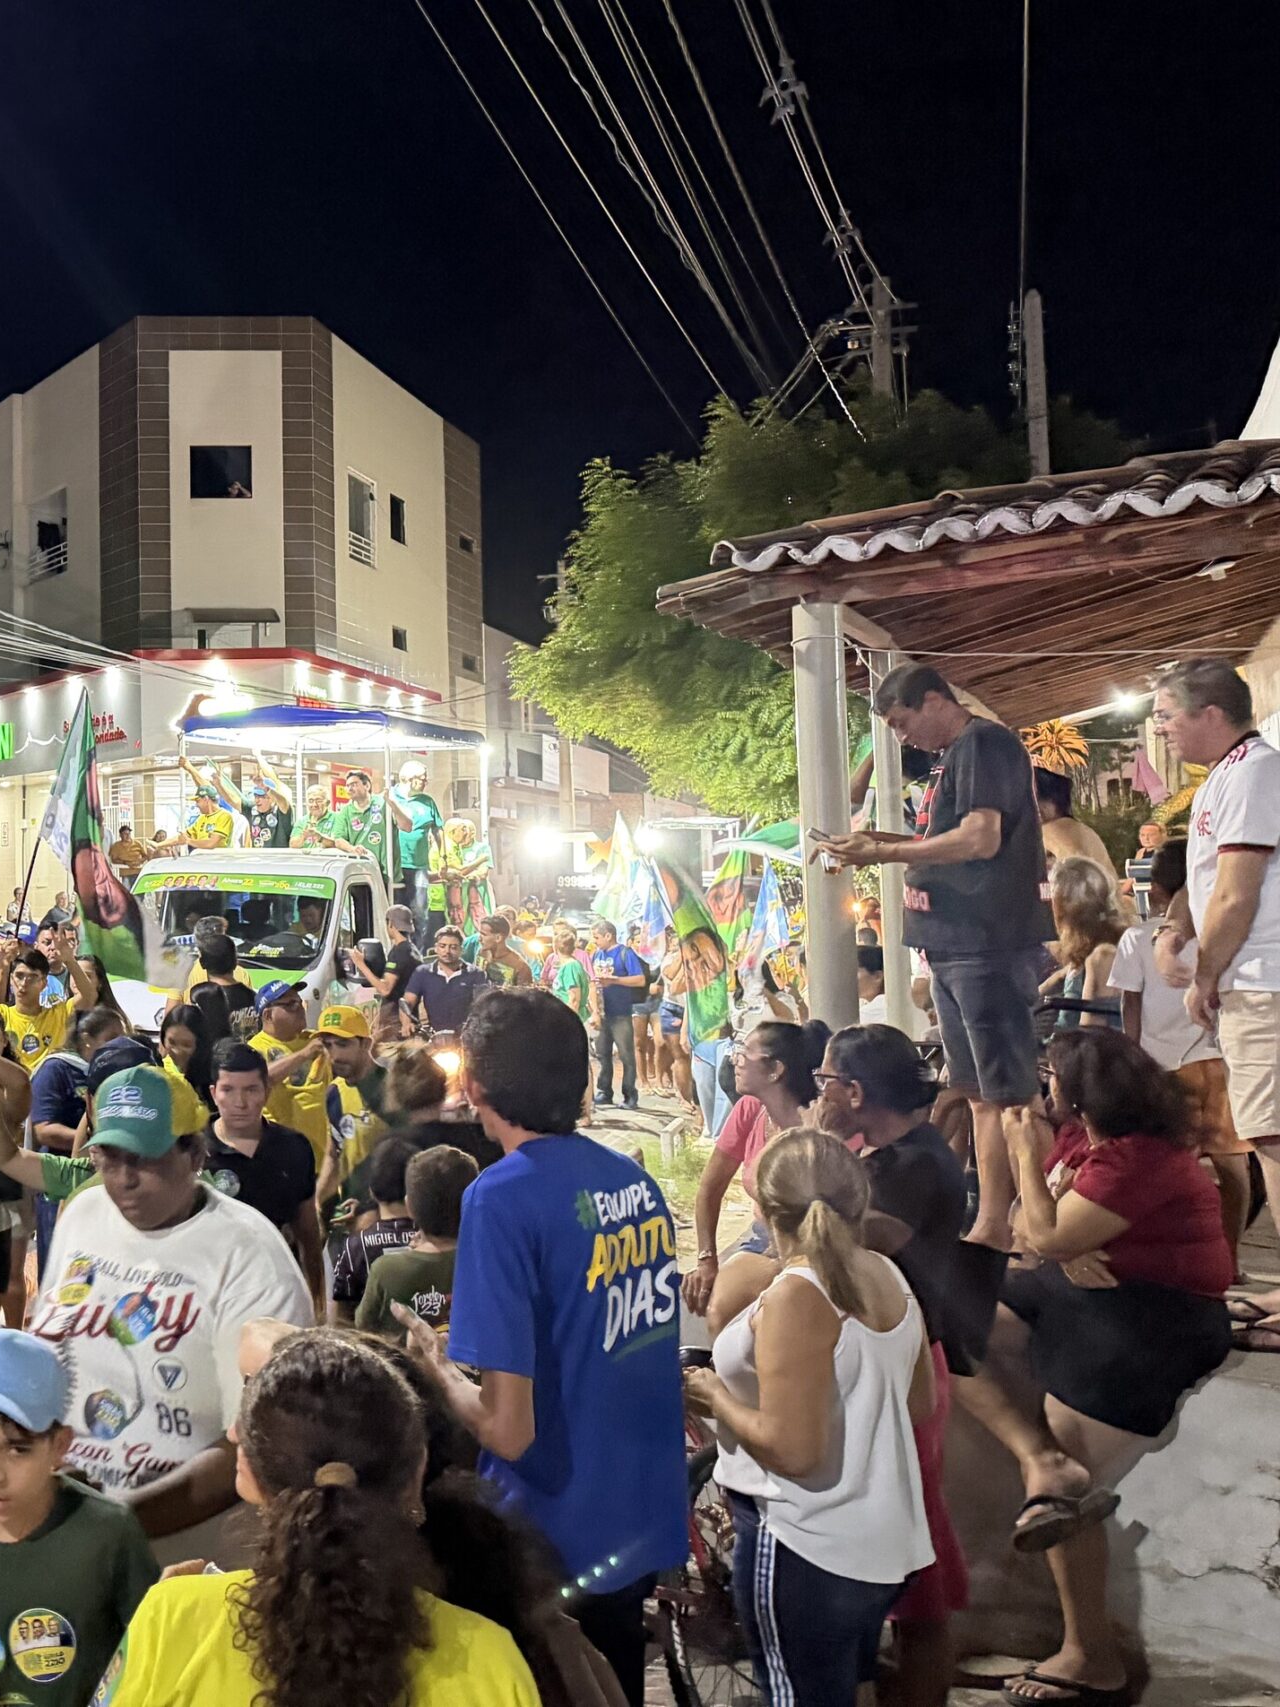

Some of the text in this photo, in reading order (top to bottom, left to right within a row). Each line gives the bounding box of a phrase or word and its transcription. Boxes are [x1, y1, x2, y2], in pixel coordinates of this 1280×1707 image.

[364, 1232, 400, 1248] MIGUEL
[420, 1302, 440, 1316] 23
[603, 1260, 677, 1352] DIAS
[156, 1402, 192, 1436] 86
